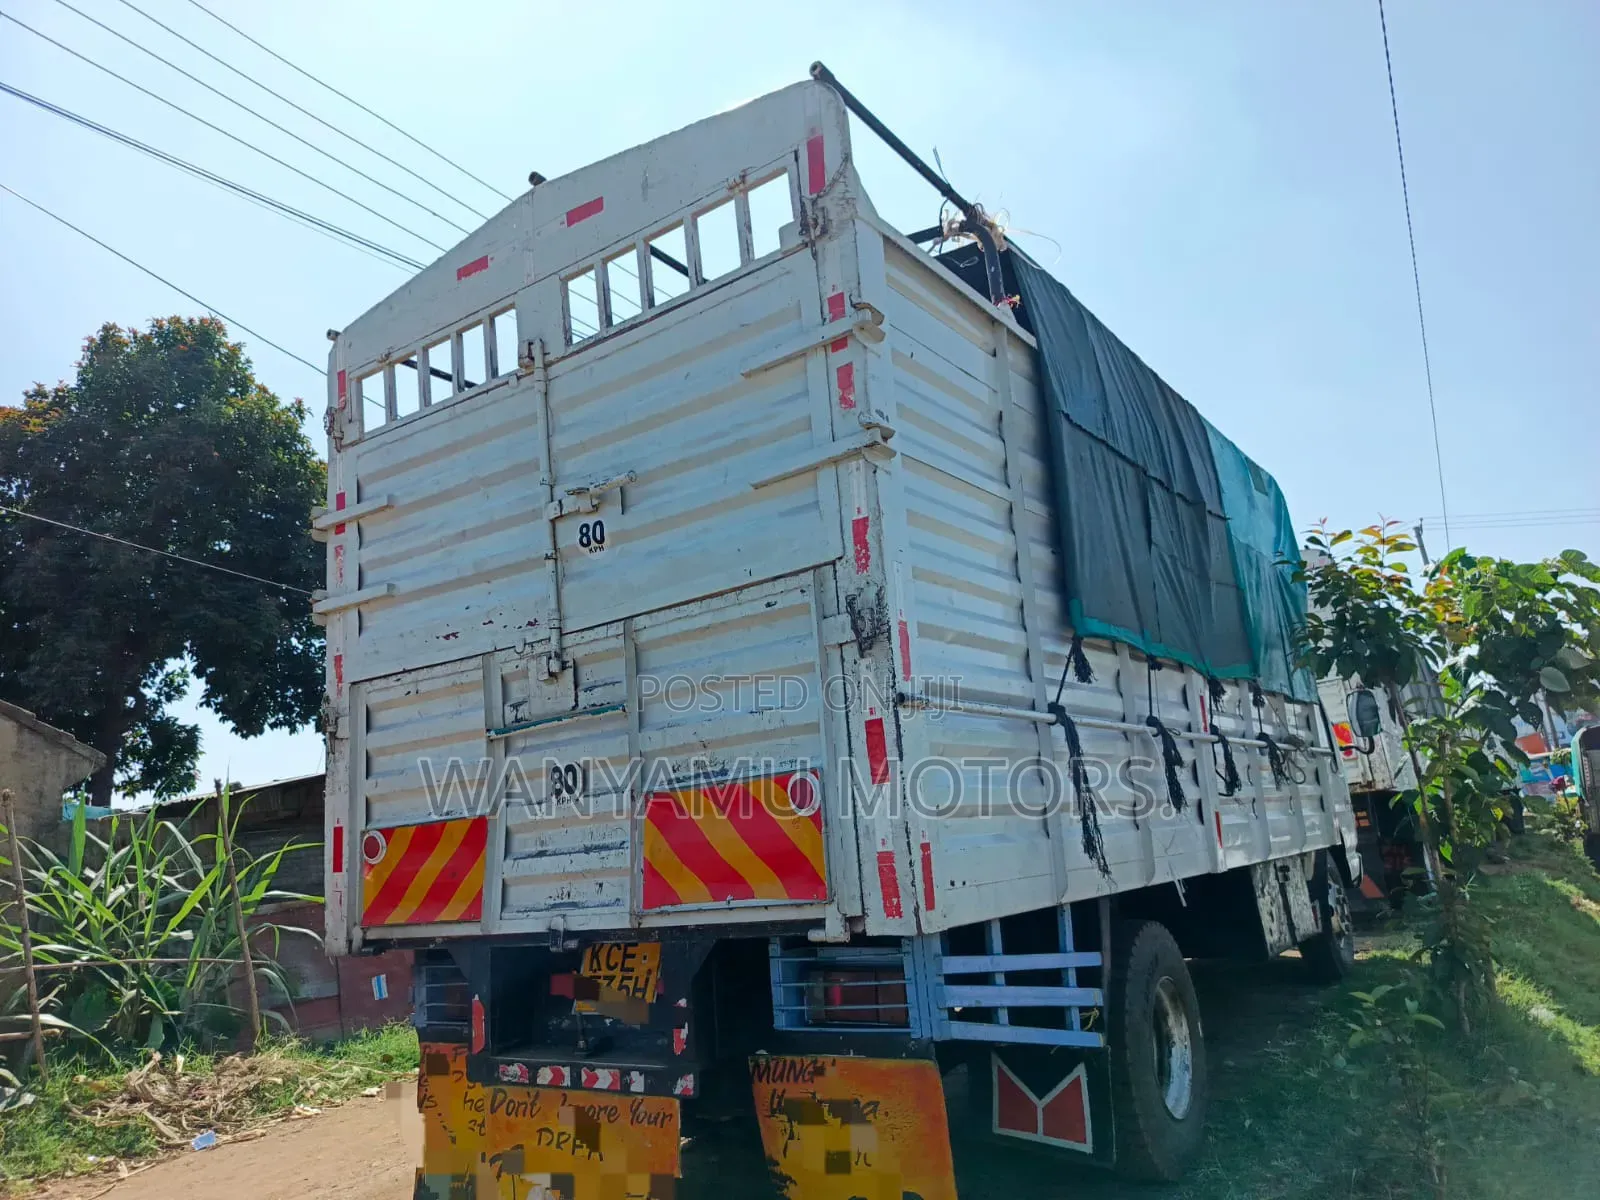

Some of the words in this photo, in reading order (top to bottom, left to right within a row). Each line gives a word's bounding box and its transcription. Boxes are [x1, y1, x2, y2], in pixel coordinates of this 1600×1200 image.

[579, 520, 605, 547] 80
[589, 545, 605, 554] KPH
[551, 764, 577, 797] 80
[589, 943, 638, 972] KCE
[490, 1088, 541, 1118] Don't
[630, 1097, 672, 1128] Your
